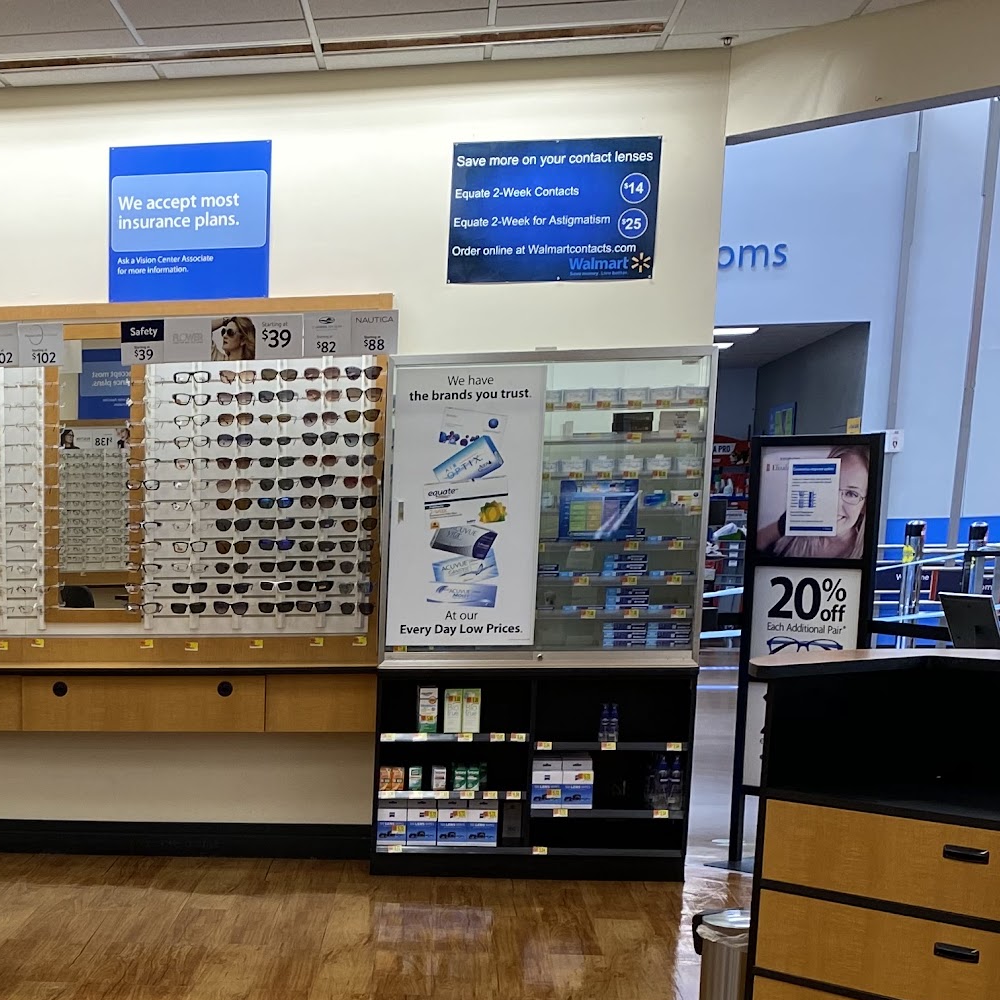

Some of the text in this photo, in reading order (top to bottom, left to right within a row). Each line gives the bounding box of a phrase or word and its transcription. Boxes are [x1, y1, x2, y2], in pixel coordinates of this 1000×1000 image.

[456, 151, 654, 168] Save more on your contact lenses
[455, 186, 580, 200] Equate 2-Week Contacts
[624, 182, 644, 194] $14
[118, 193, 240, 212] We accept most
[118, 211, 240, 231] insurance plans.
[453, 214, 611, 229] Equate 2-Week for Astigmatism
[621, 218, 642, 230] $25
[452, 243, 636, 256] Order online at Walmartcontacts.com
[117, 257, 130, 265] Ask
[135, 256, 157, 264] Vision
[569, 256, 629, 270] Walmart
[117, 267, 127, 275] for
[147, 266, 189, 274] information.
[355, 316, 393, 324] NAUTICA
[130, 327, 158, 338] Safety
[261, 328, 292, 349] $39
[316, 341, 336, 353] $82
[363, 339, 385, 351] $88
[31, 352, 56, 364] $102
[134, 349, 154, 361] $39
[447, 375, 494, 386] We have
[409, 389, 532, 402] the brands you trust.
[718, 445, 731, 453] PRO
[427, 488, 456, 498] equate
[442, 560, 468, 571] ACUVUE
[767, 576, 847, 620] 20%
[445, 611, 478, 620] At our
[820, 604, 847, 622] off
[400, 623, 523, 636] Every Day Low Prices.
[767, 622, 785, 632] Each
[786, 623, 826, 634] Additional
